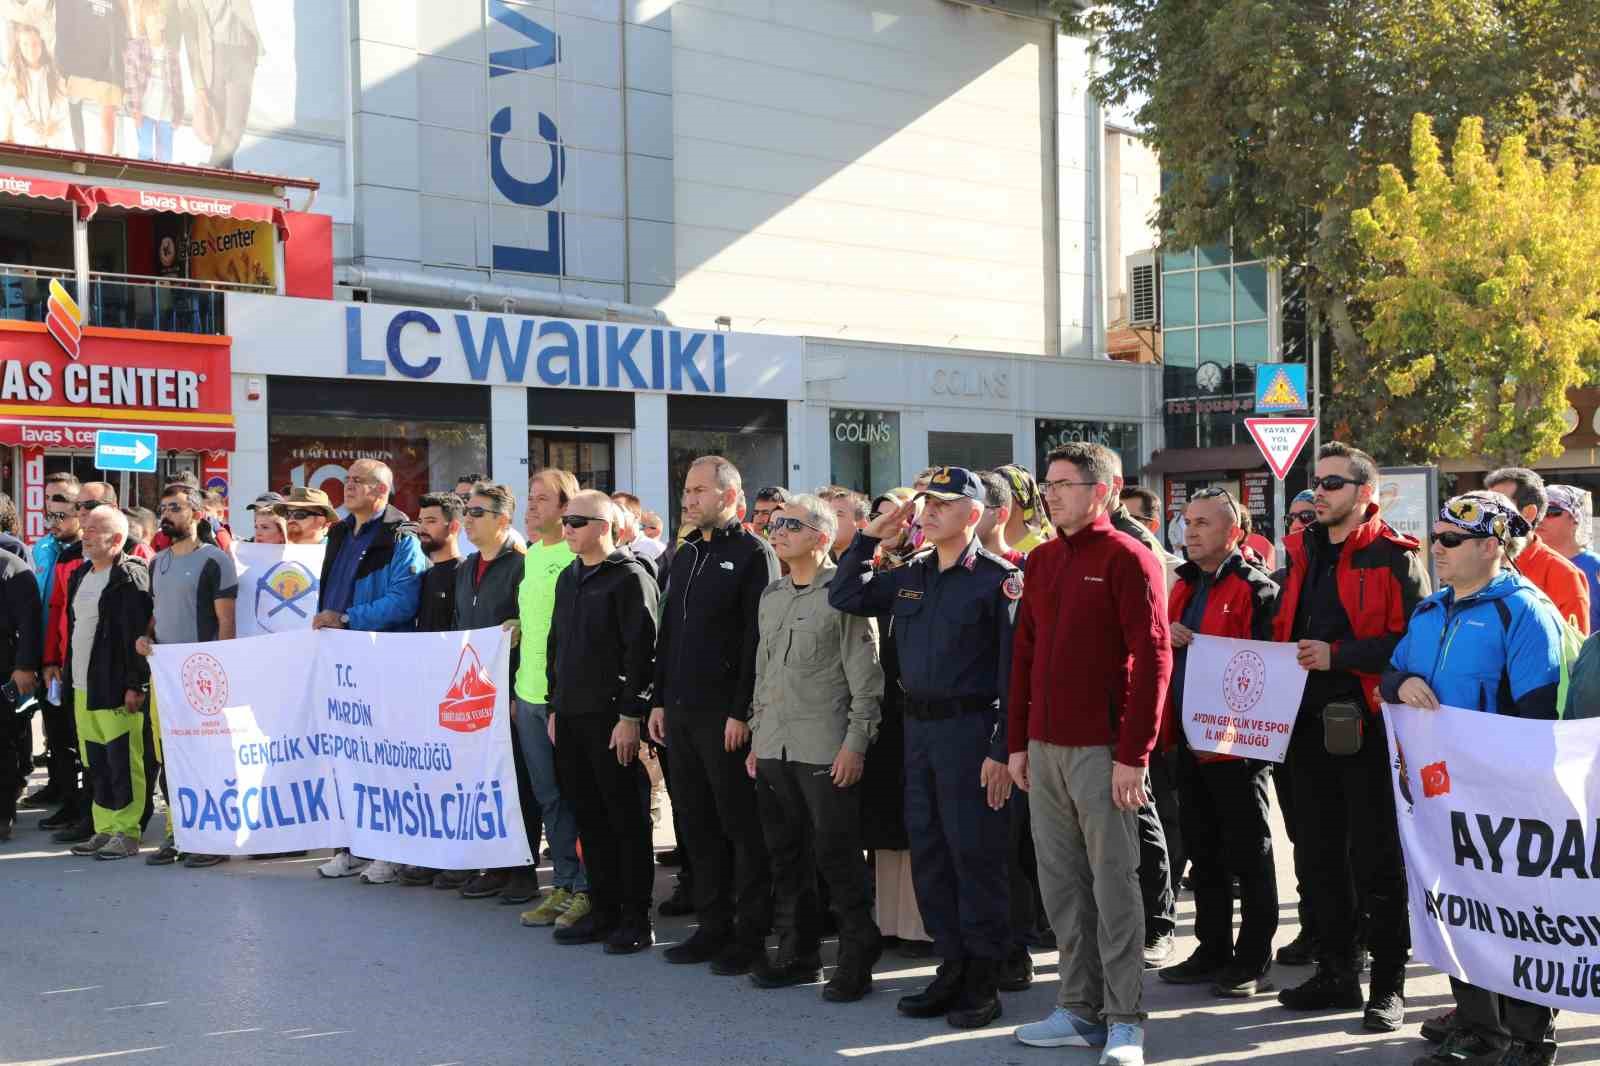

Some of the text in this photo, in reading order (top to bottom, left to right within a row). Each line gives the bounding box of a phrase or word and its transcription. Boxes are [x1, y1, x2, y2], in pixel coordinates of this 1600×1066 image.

[190, 199, 234, 215] center
[216, 228, 256, 253] center
[345, 306, 442, 379] LC
[0, 359, 200, 408] AS CENTER
[835, 420, 890, 442] COLIN'S
[1263, 426, 1297, 434] YAYAYA
[1271, 435, 1288, 443] YOL
[335, 663, 357, 688] T.C.
[327, 697, 373, 728] MARDİN
[1193, 712, 1216, 725] AYDIN
[1251, 719, 1264, 731] VE
[1265, 721, 1290, 734] SPOR
[238, 735, 305, 767] GENÇLİK
[306, 733, 330, 756] VE
[359, 735, 374, 763] İL
[374, 738, 452, 771] MÜDÜRLÜĞÜ
[177, 777, 330, 832] DAĞCILIK
[1423, 887, 1496, 935] AYDIN
